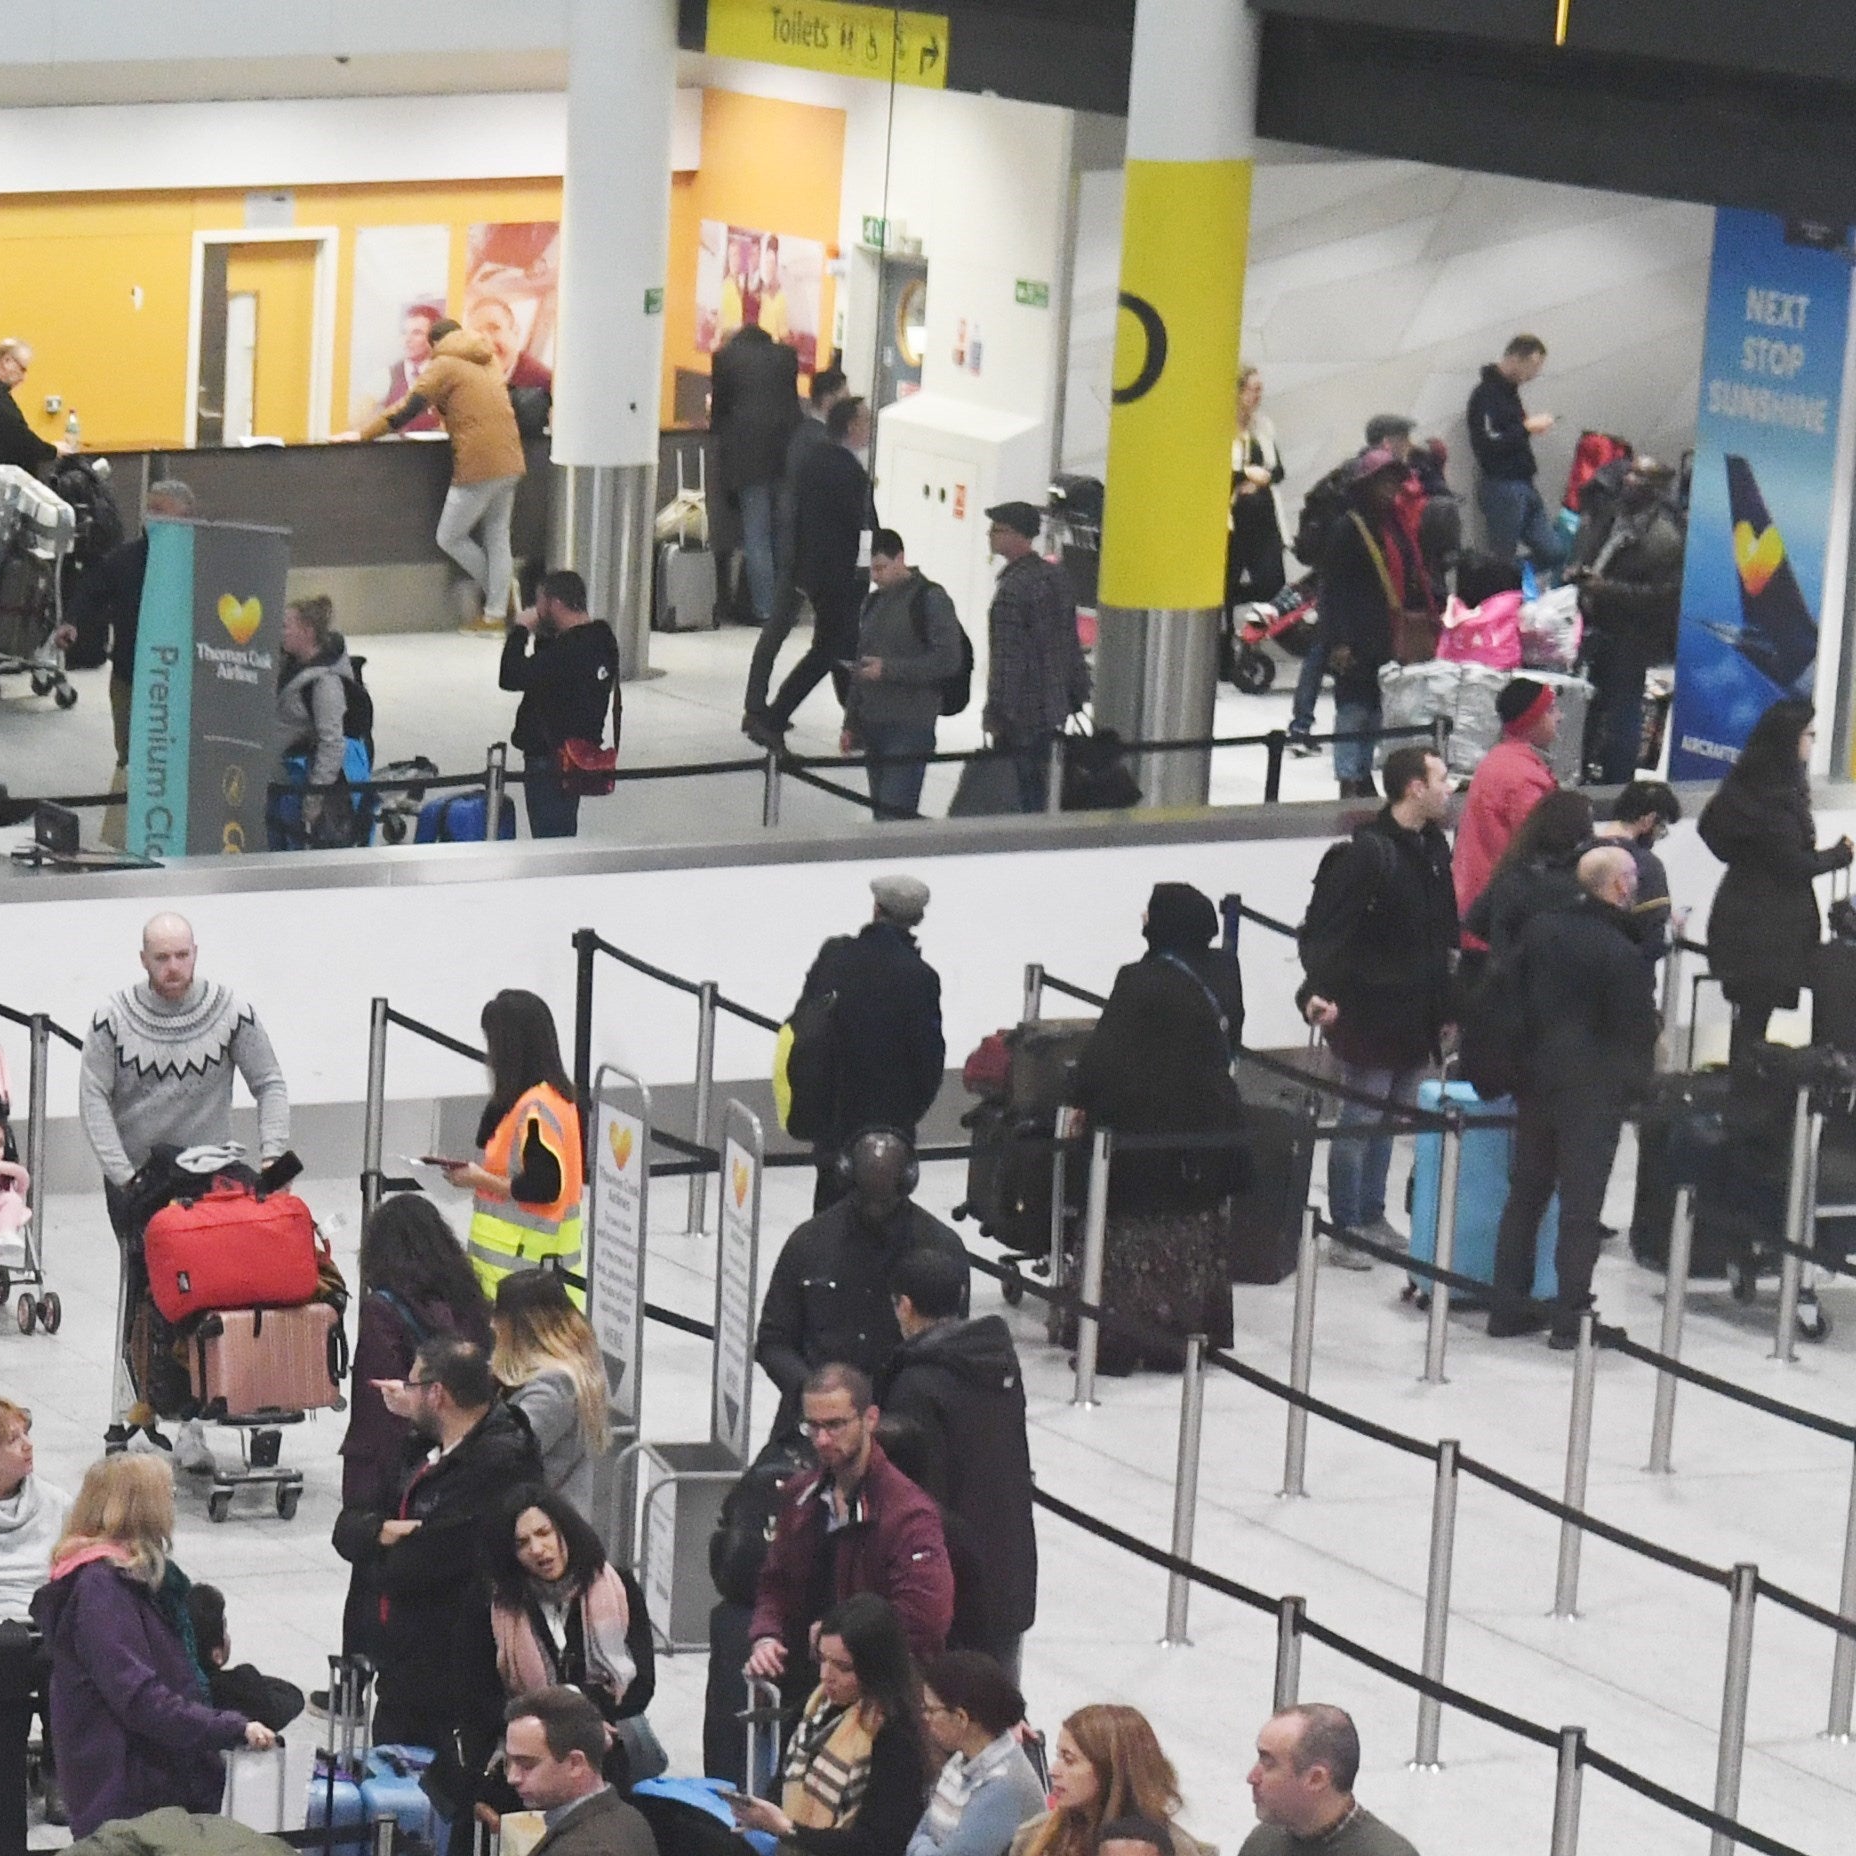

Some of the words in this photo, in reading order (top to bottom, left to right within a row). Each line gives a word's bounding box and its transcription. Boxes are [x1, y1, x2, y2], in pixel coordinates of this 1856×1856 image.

[772, 6, 830, 49] Toilets
[1746, 287, 1811, 332] NEXT
[1740, 335, 1806, 377] STOP
[1708, 379, 1828, 435] SUNSHINE
[196, 642, 248, 667] Thomas
[217, 662, 259, 685] Airlines
[146, 645, 180, 798] Premium
